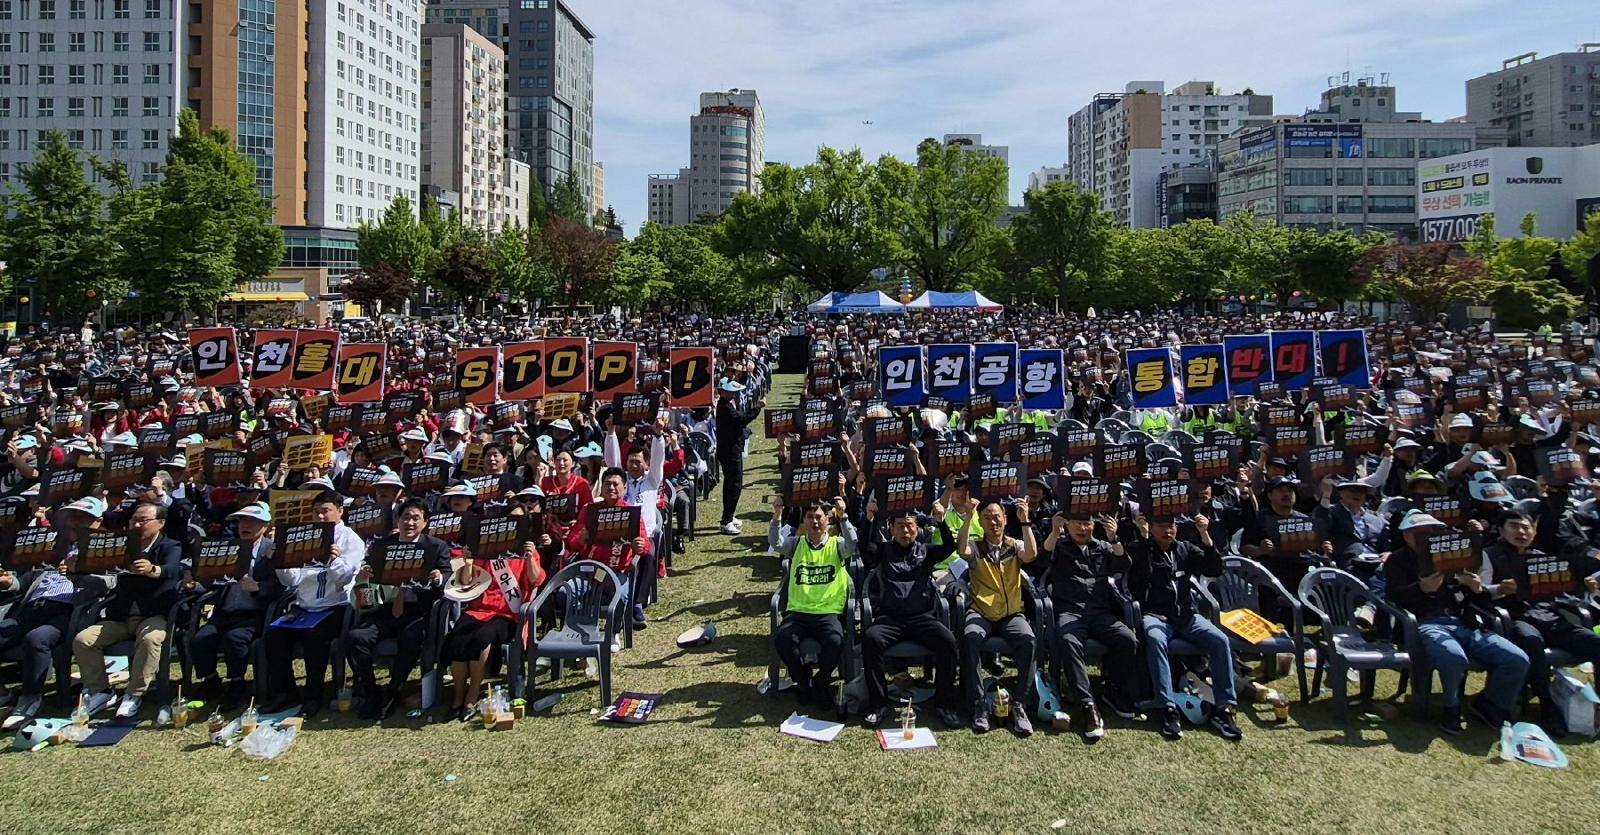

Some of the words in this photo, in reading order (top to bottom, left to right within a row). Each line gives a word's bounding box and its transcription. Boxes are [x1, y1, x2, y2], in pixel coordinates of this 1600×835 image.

[1423, 196, 1440, 211] 무상
[1443, 194, 1461, 210] 선택
[623, 398, 650, 408] 인천공항
[876, 421, 903, 431] 인천공항
[801, 446, 832, 458] 인천공항
[939, 446, 970, 457] 인천공항
[1021, 444, 1052, 456] 인천공항
[1105, 450, 1136, 462] 인천공항
[1194, 450, 1228, 461] 인천공항
[1310, 450, 1343, 462] 인천공항
[111, 458, 143, 469] 인천공항
[214, 454, 245, 465] 인천공항
[874, 453, 904, 463] 인천공항
[412, 467, 439, 478] 인천공항
[793, 470, 828, 482] 인천공항
[981, 468, 1017, 479] 인천공항
[50, 473, 83, 486] 인천공항
[887, 481, 924, 493] 인천공항
[1071, 484, 1108, 495] 인천공항
[1151, 486, 1188, 497] 인천공항
[1425, 499, 1459, 512] 인천공항
[348, 509, 381, 523] 인천공항
[429, 516, 462, 528] 인천공항
[597, 511, 630, 521] 인천공항
[480, 521, 517, 534] 인천공항
[1279, 522, 1313, 533] 인천공항
[16, 532, 57, 546] 인천공항
[88, 536, 127, 548] 인천공항
[286, 529, 323, 543] 인천공항
[199, 545, 240, 556] 인천공항
[1430, 538, 1471, 554] 인천공항
[386, 548, 425, 560] 인천공항
[1528, 561, 1569, 575] 인천공항
[492, 559, 521, 603] 배우자
